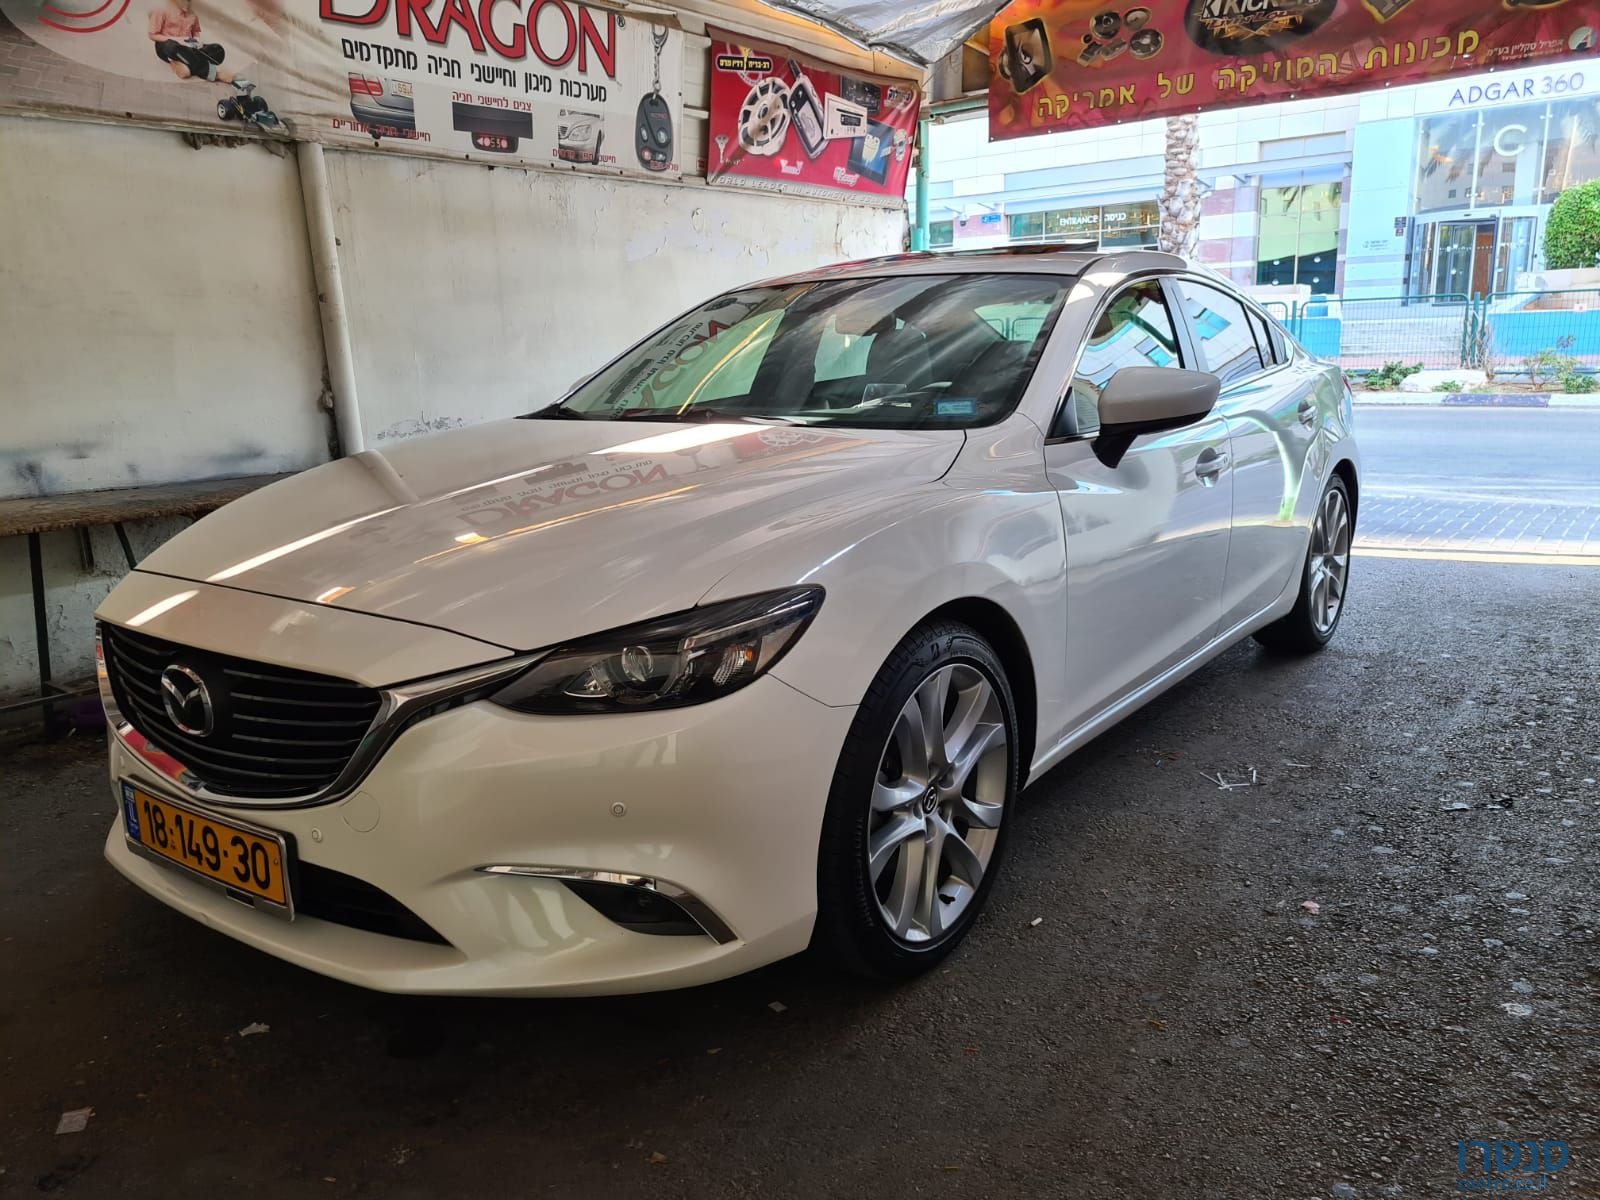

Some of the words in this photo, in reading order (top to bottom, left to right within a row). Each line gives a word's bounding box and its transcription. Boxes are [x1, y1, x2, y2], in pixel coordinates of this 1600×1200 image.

[341, 38, 418, 70] מתקדמים
[1364, 29, 1480, 71] מכונות
[427, 55, 462, 79] חניה
[470, 63, 516, 88] וחיישני
[1217, 53, 1339, 93] המוזיקה
[525, 72, 552, 93] מיגון
[559, 79, 607, 102] מערכות
[1157, 72, 1195, 98] של
[1449, 79, 1535, 107] ADGAR
[1541, 72, 1585, 95] 360
[452, 91, 472, 104] חניה
[478, 95, 508, 108] לחיישני
[1038, 84, 1136, 120] אמריקה
[1494, 124, 1528, 157] C
[1060, 214, 1099, 226] ENTRANCE
